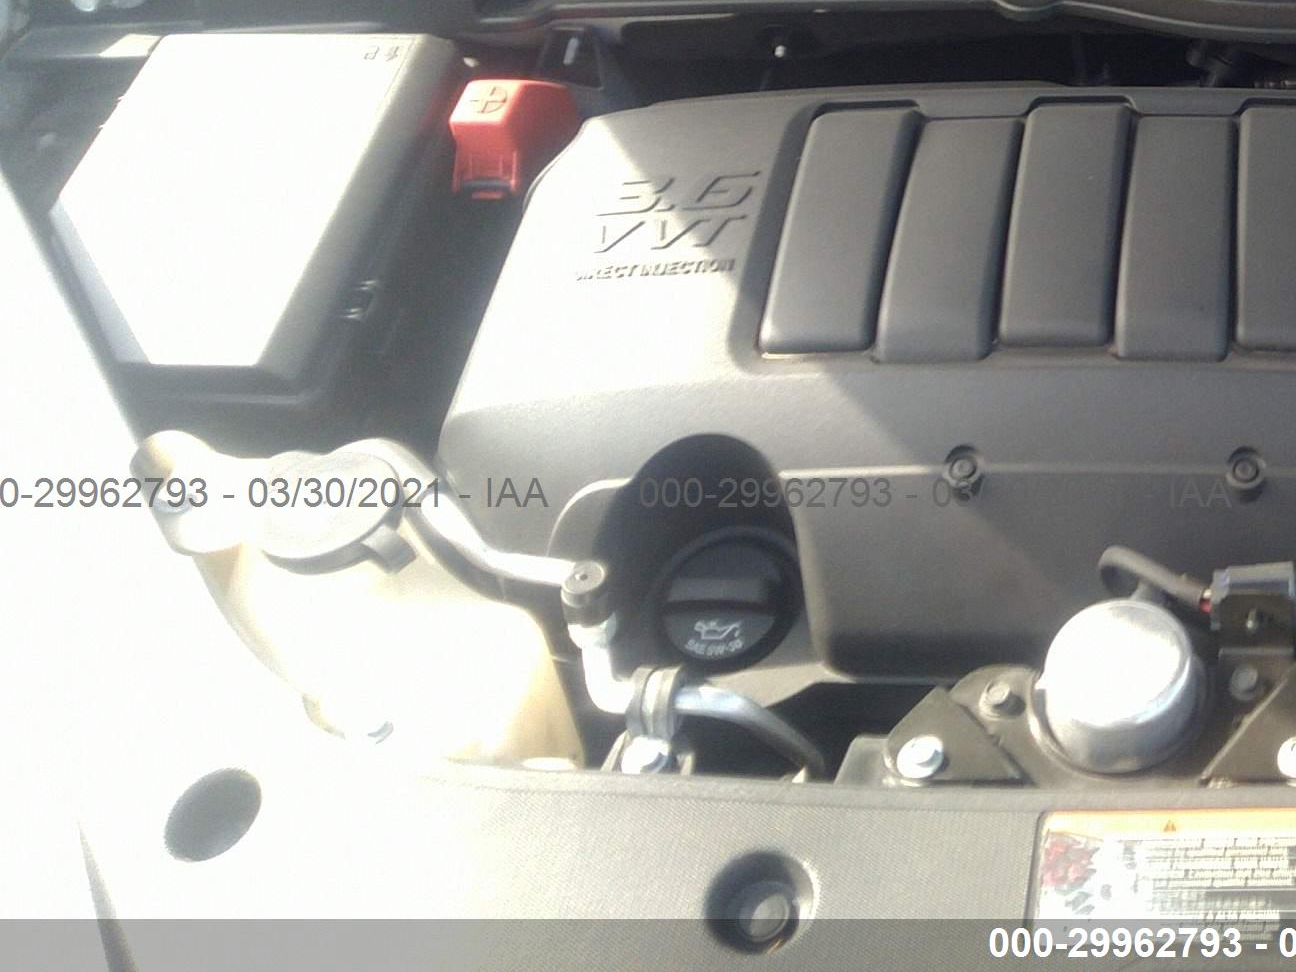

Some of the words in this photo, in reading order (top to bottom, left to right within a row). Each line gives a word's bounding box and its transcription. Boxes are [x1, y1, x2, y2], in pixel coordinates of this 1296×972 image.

[596, 171, 761, 216] 3.6
[594, 214, 747, 254] VVT
[576, 264, 638, 280] ECT
